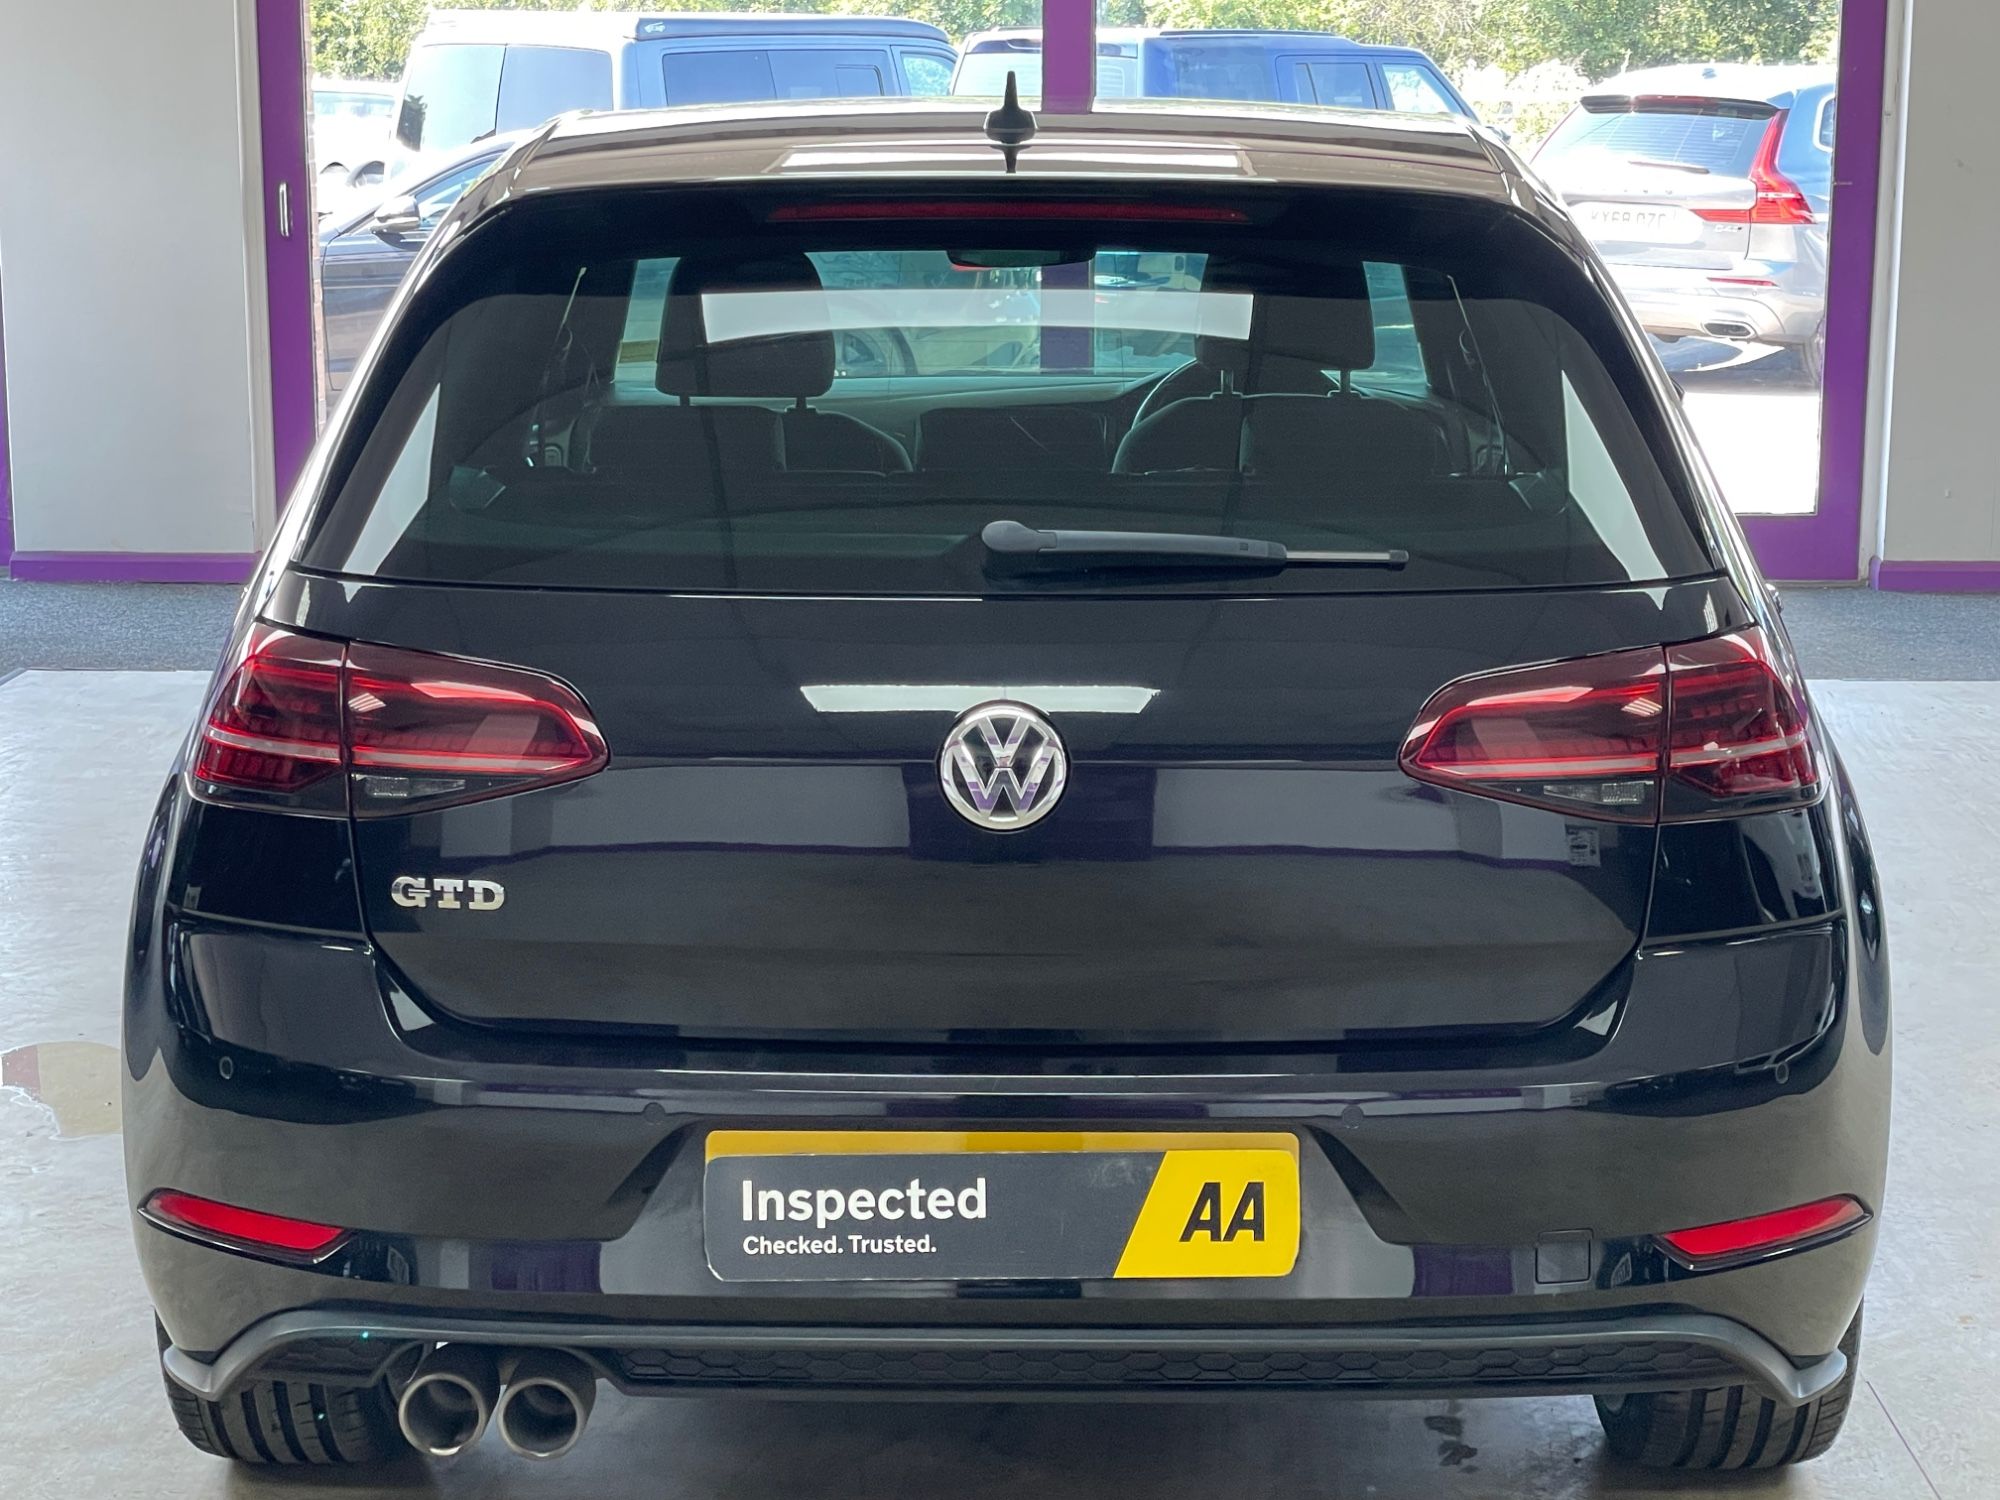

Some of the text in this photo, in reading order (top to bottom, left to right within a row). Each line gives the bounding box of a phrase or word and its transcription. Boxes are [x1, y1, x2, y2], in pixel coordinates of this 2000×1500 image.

[945, 709, 1061, 821] VW
[391, 876, 505, 911] GTD
[742, 1177, 987, 1229] Inspected
[1179, 1182, 1265, 1242] AA
[742, 1233, 937, 1255] Checked. Trusted.
